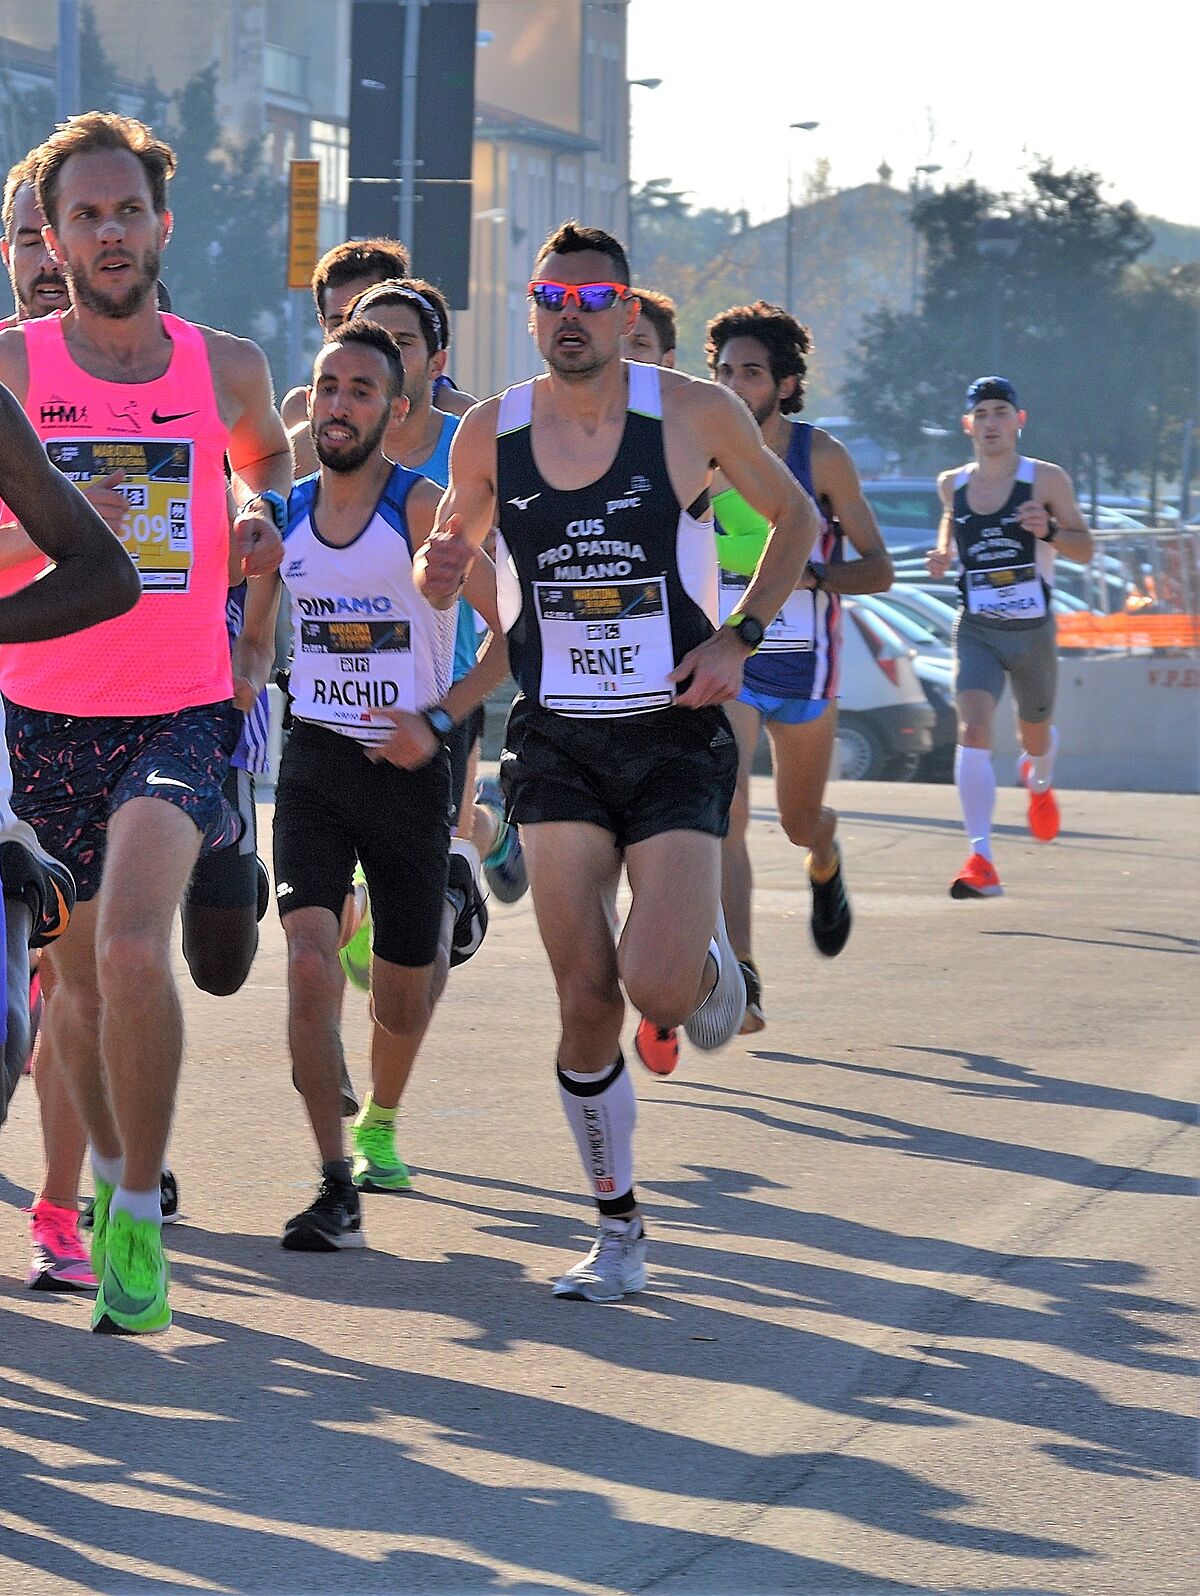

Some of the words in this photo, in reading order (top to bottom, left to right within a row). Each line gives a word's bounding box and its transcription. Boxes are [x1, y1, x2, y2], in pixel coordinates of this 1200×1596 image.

[605, 497, 642, 514] pwc
[565, 519, 606, 538] CUS
[537, 543, 573, 570] PRO
[576, 540, 647, 562] PATRIA
[553, 560, 632, 580] MILANO
[298, 596, 392, 616] DINAMO
[569, 644, 641, 675] RENE'
[312, 678, 399, 708] RACHID
